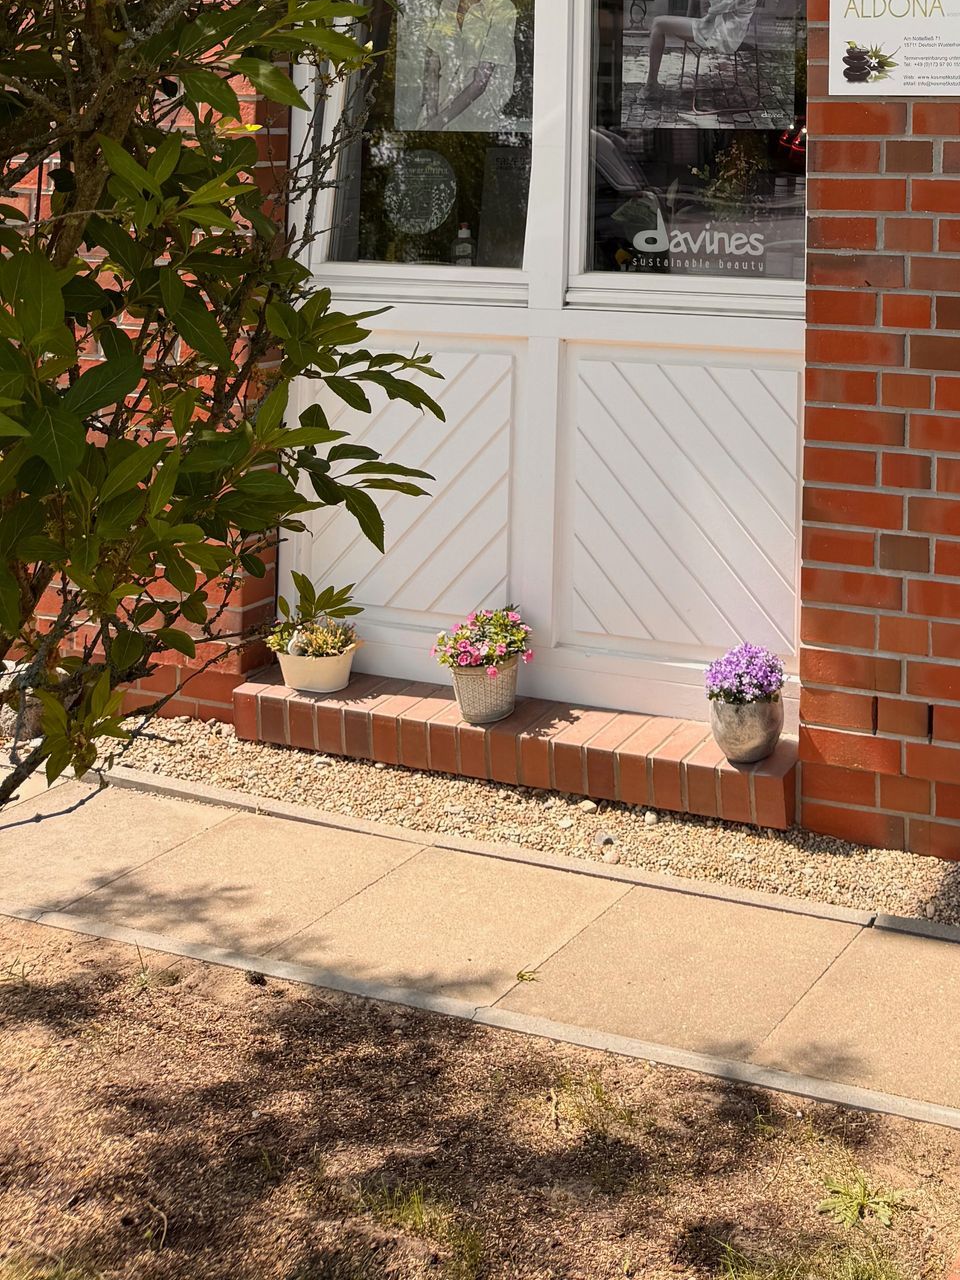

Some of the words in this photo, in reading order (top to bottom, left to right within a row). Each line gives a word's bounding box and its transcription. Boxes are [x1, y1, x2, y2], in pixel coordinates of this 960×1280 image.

[632, 207, 765, 256] davines
[632, 255, 710, 269] sustainable
[718, 258, 765, 272] beauty
